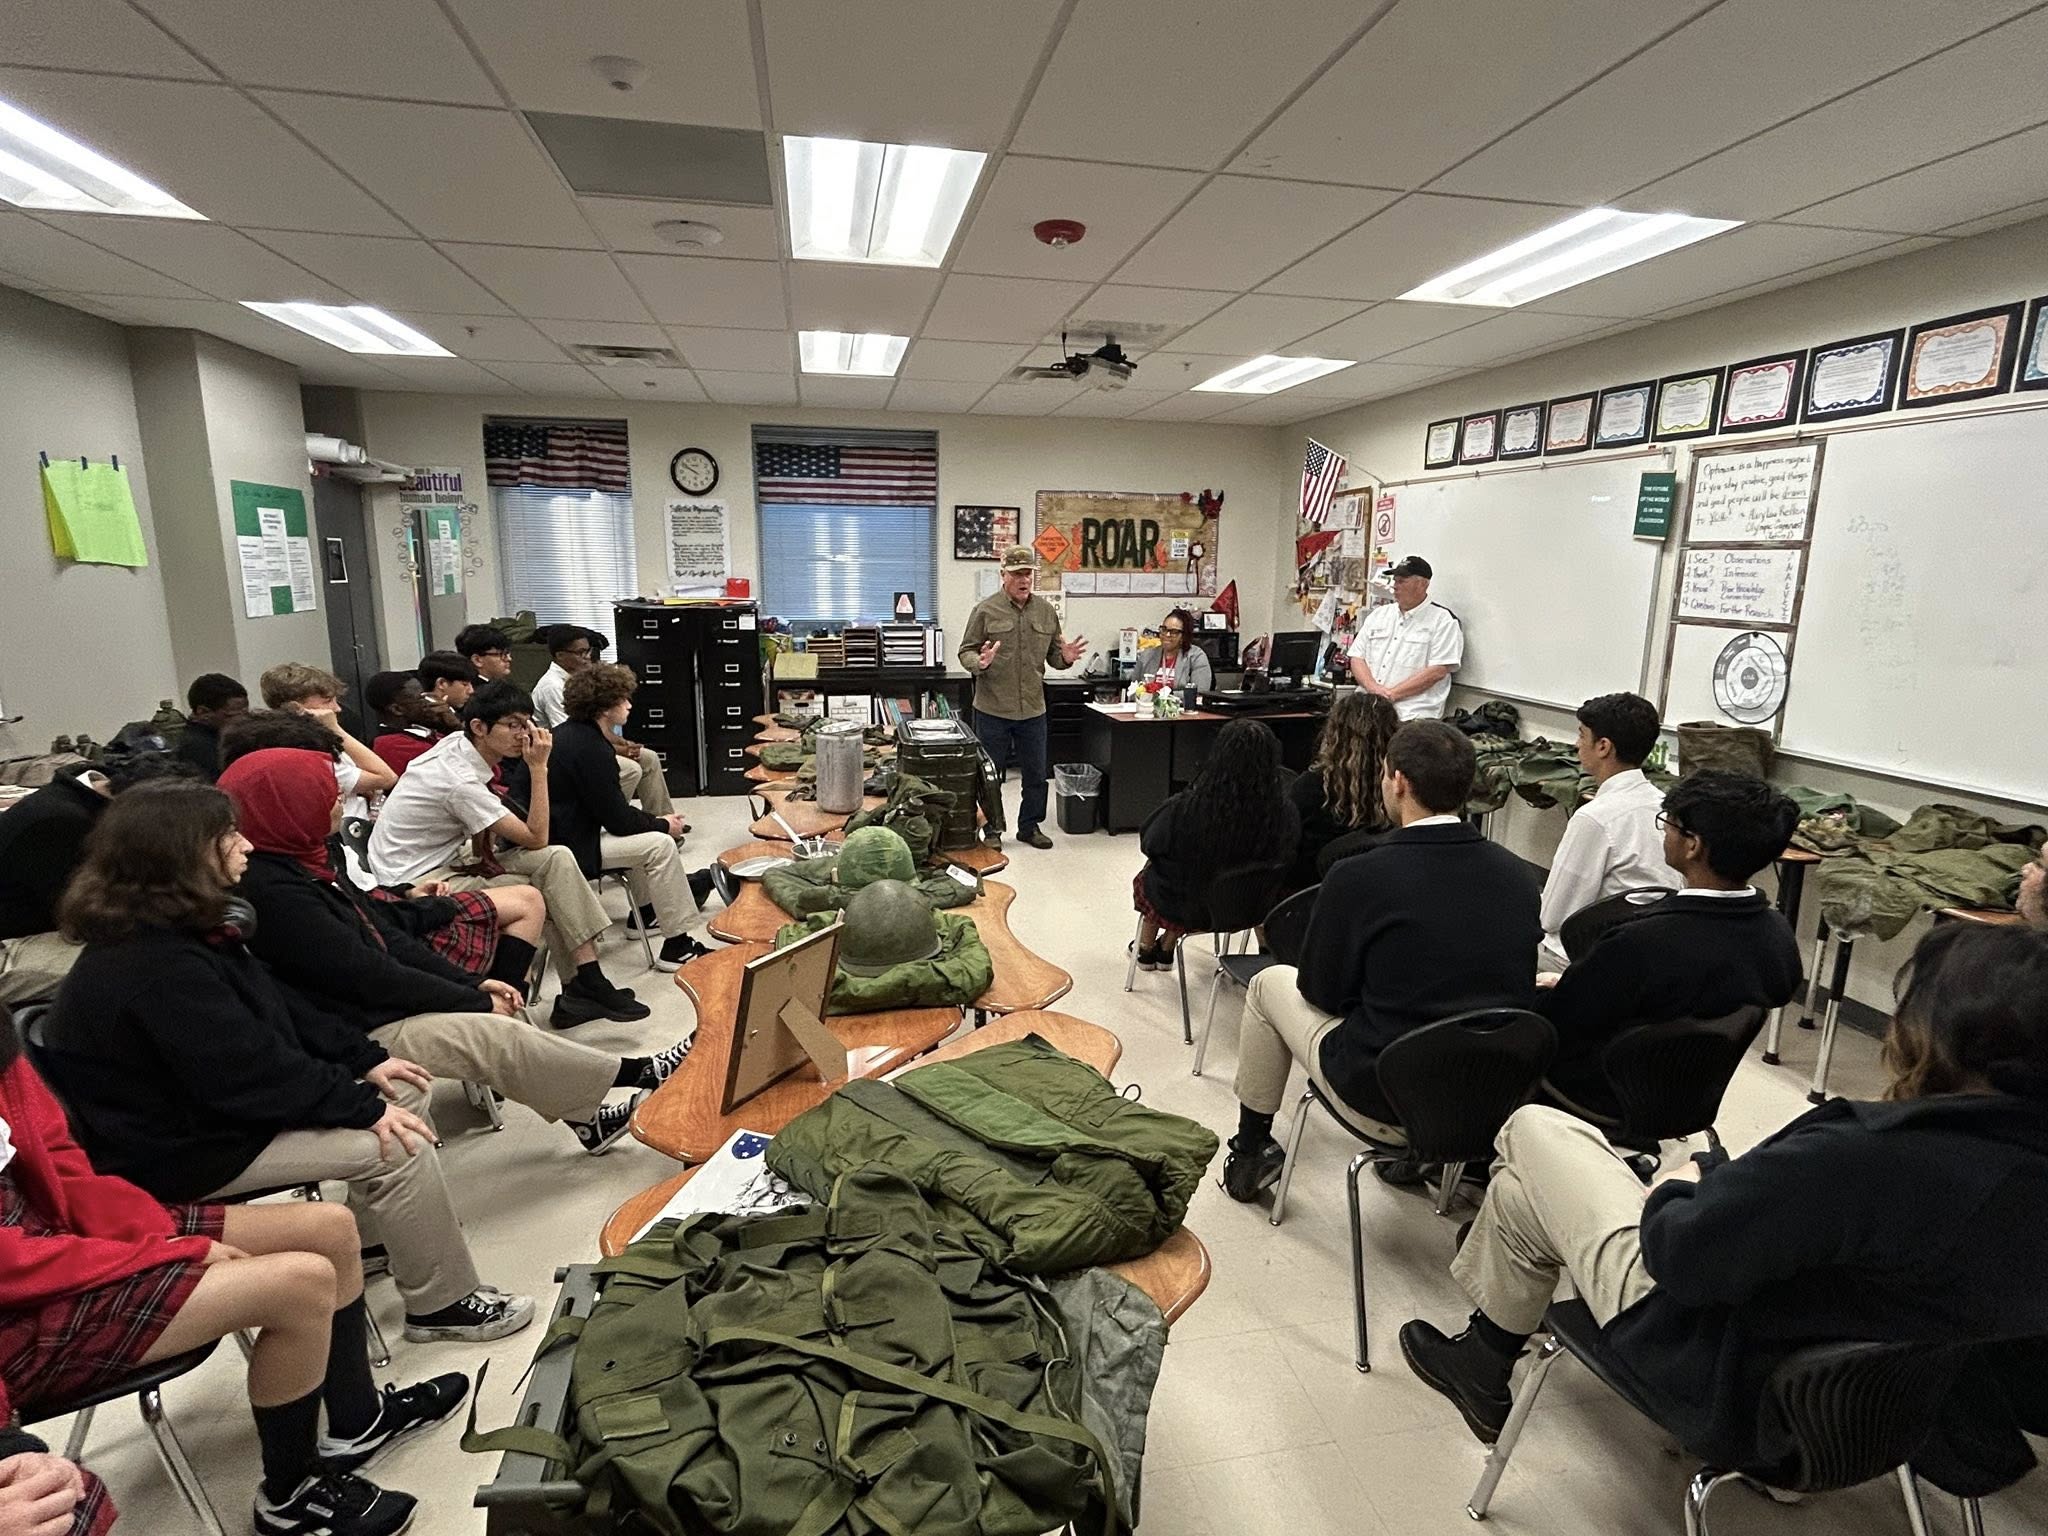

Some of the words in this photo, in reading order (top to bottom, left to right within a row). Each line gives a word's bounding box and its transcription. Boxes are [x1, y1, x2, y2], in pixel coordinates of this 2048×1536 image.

[399, 473, 462, 491] autiful
[400, 492, 432, 503] human
[1082, 517, 1160, 569] ROAR
